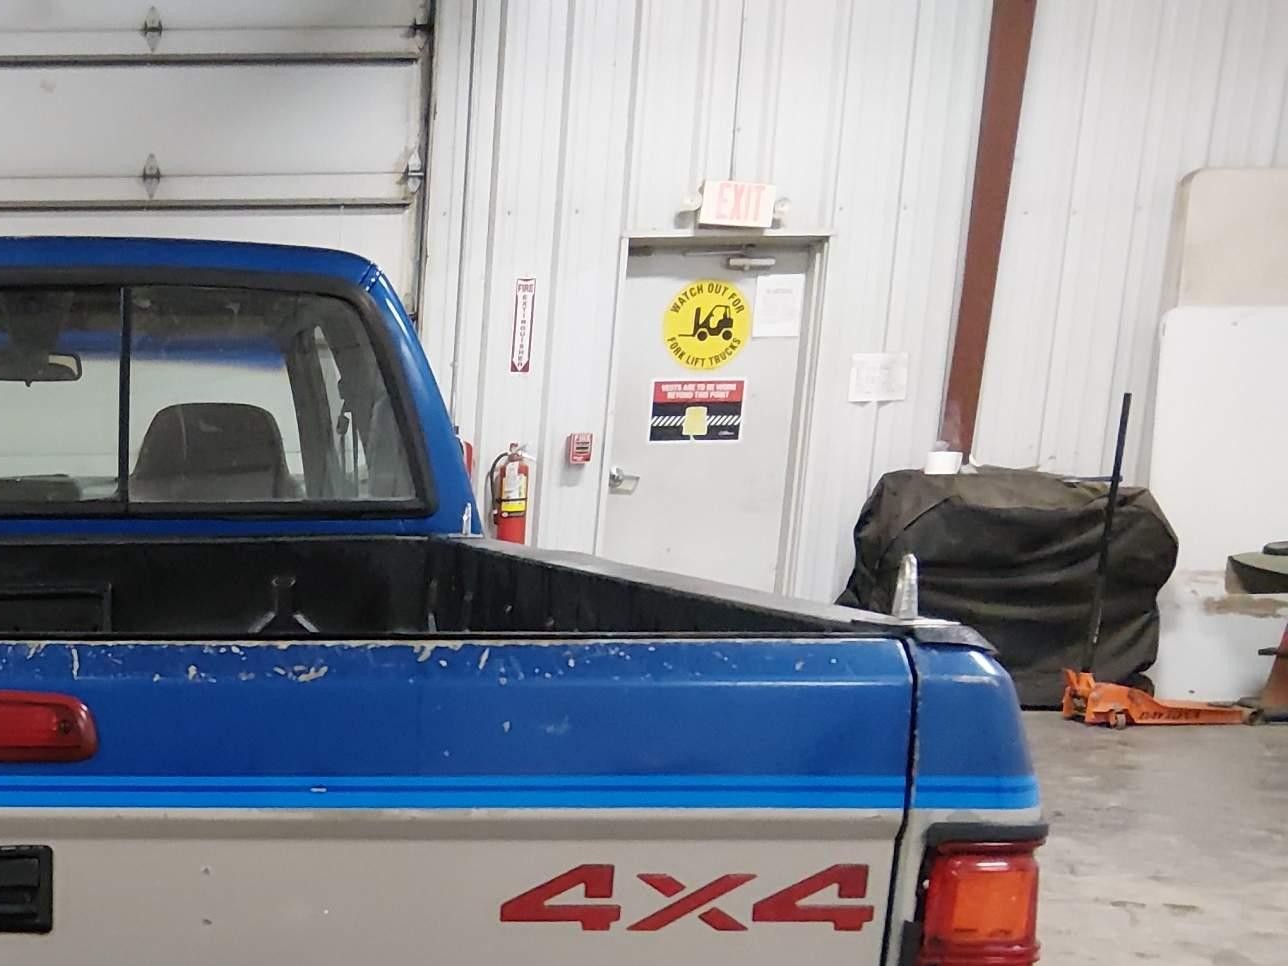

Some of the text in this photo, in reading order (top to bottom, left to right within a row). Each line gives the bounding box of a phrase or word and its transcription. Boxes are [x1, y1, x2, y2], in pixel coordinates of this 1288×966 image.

[715, 182, 766, 222] EXIT
[518, 284, 534, 293] FIRE
[670, 282, 745, 314] WATCH OUT FOR
[667, 336, 742, 368] FORK LIFT TRUCKS
